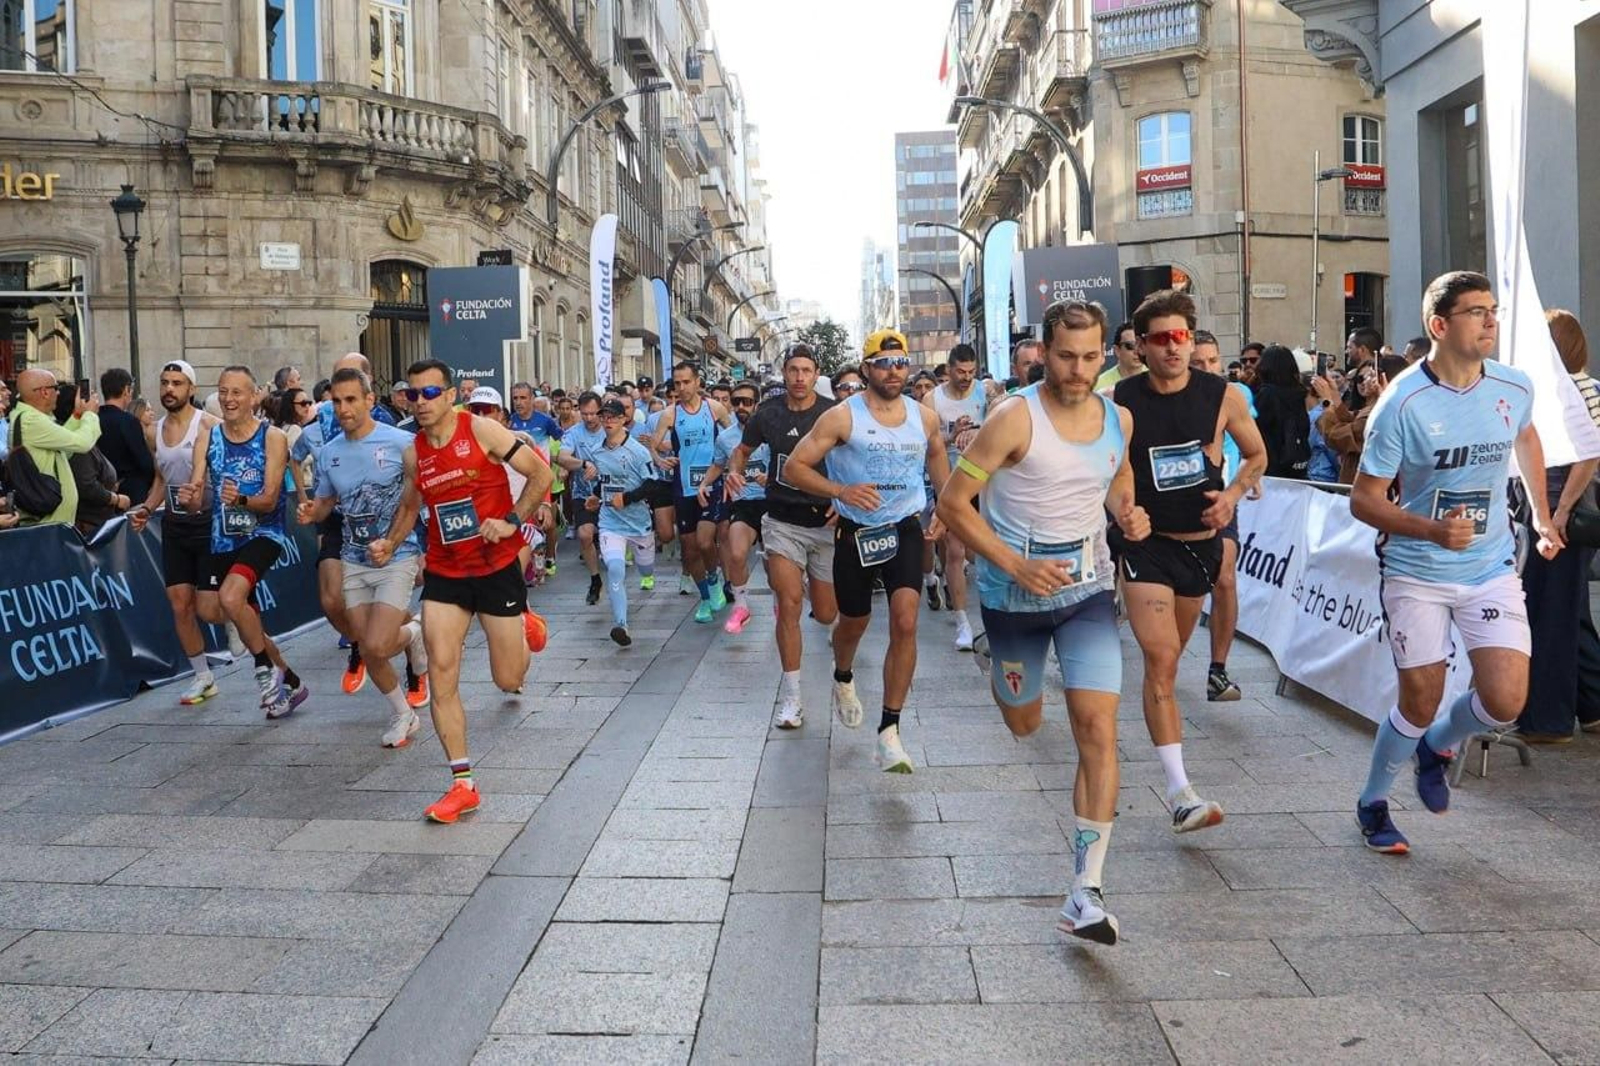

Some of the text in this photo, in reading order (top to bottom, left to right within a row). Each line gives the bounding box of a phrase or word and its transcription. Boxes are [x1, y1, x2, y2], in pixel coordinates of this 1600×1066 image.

[1151, 171, 1188, 183] Occident
[1353, 171, 1381, 181] Occident
[1053, 276, 1111, 290] FUNDACIÓN
[1053, 289, 1086, 300] CELTA
[456, 297, 512, 310] FUNDACIÓN
[598, 259, 611, 352] Profand
[455, 309, 487, 320] CELTA
[456, 368, 495, 378] Profand
[1158, 459, 1202, 479] 2290
[228, 515, 251, 526] 464
[444, 515, 474, 532] 304
[862, 535, 898, 554] 1098
[1237, 532, 1295, 589] fand
[0, 565, 134, 633] FUNDAÓN
[1304, 584, 1337, 622] the
[10, 624, 106, 682] CELTA
